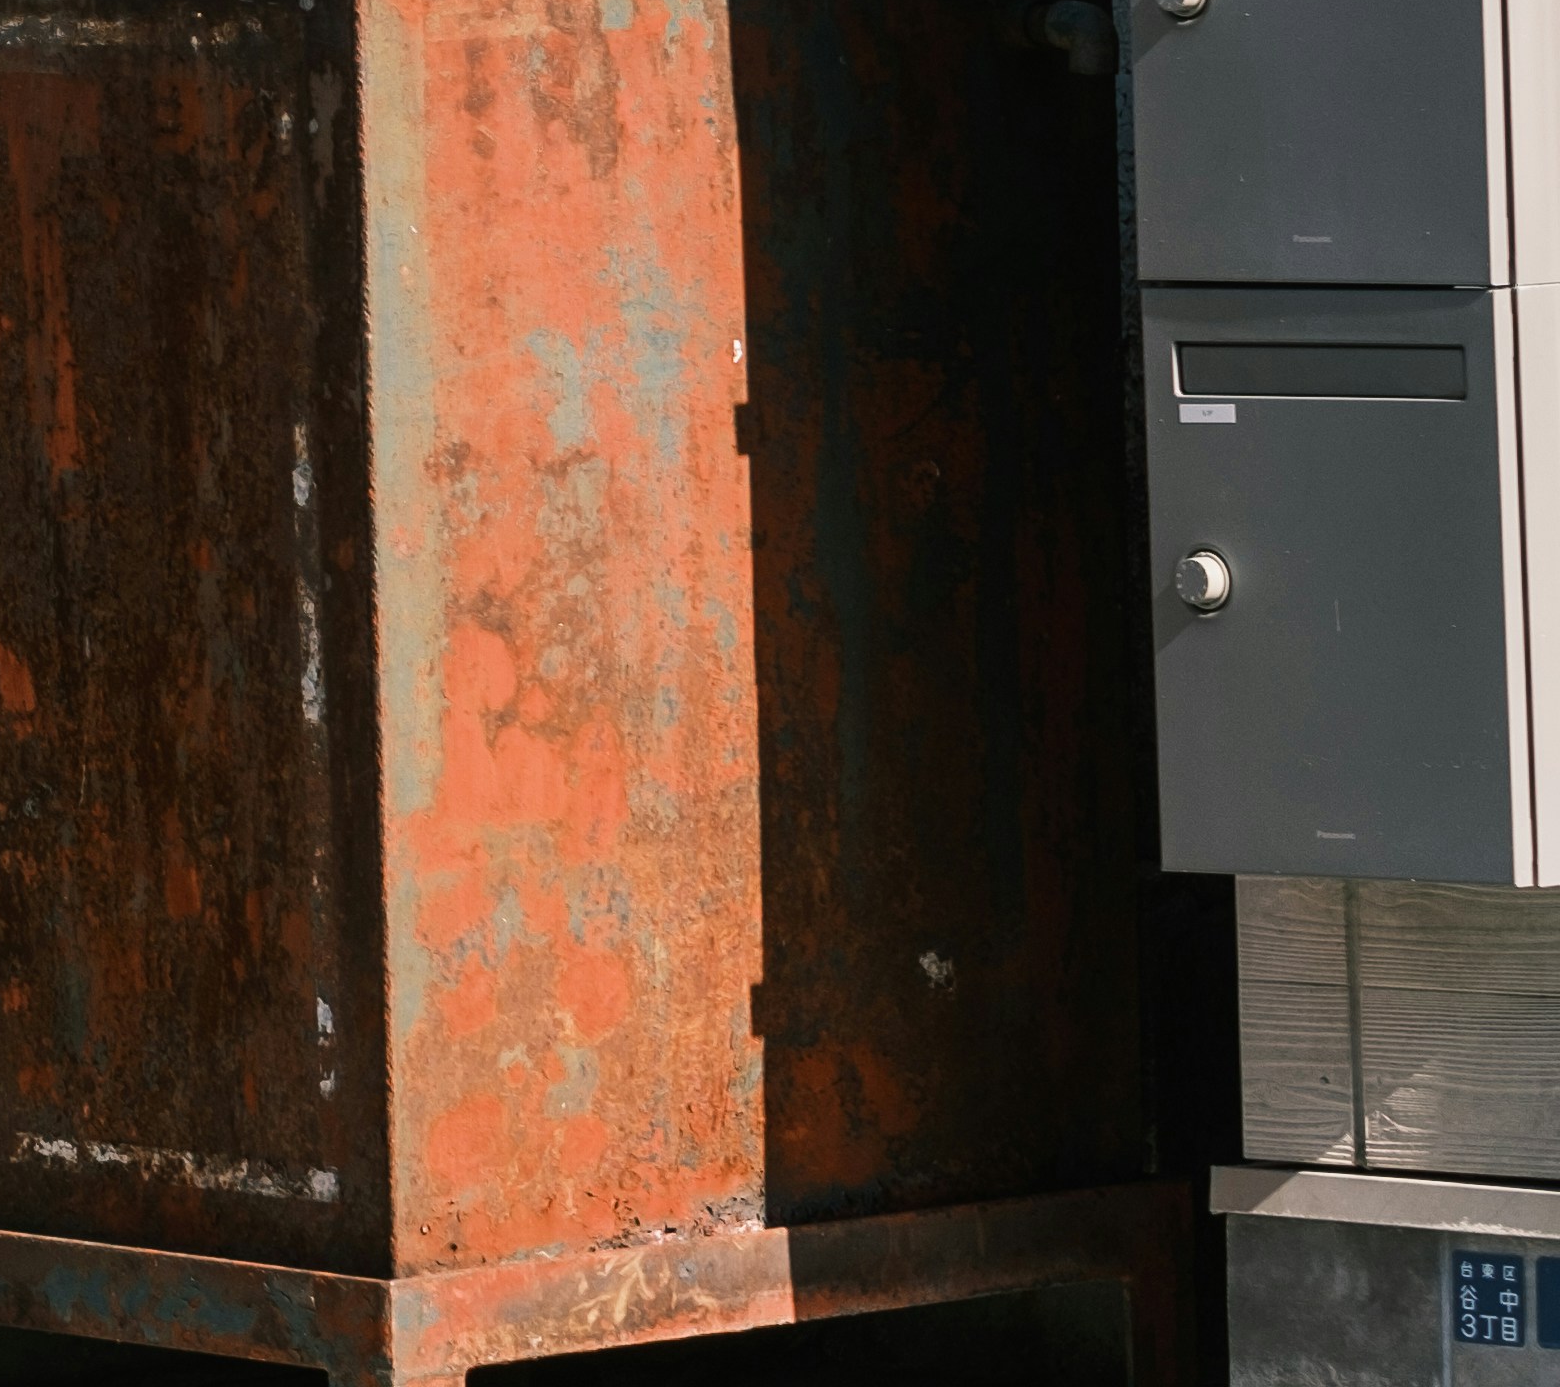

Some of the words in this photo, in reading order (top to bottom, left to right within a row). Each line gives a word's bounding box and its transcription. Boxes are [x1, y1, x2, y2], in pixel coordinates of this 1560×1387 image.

[1460, 1260, 1518, 1282] 台東区
[1460, 1313, 1518, 1342] 3丁目
